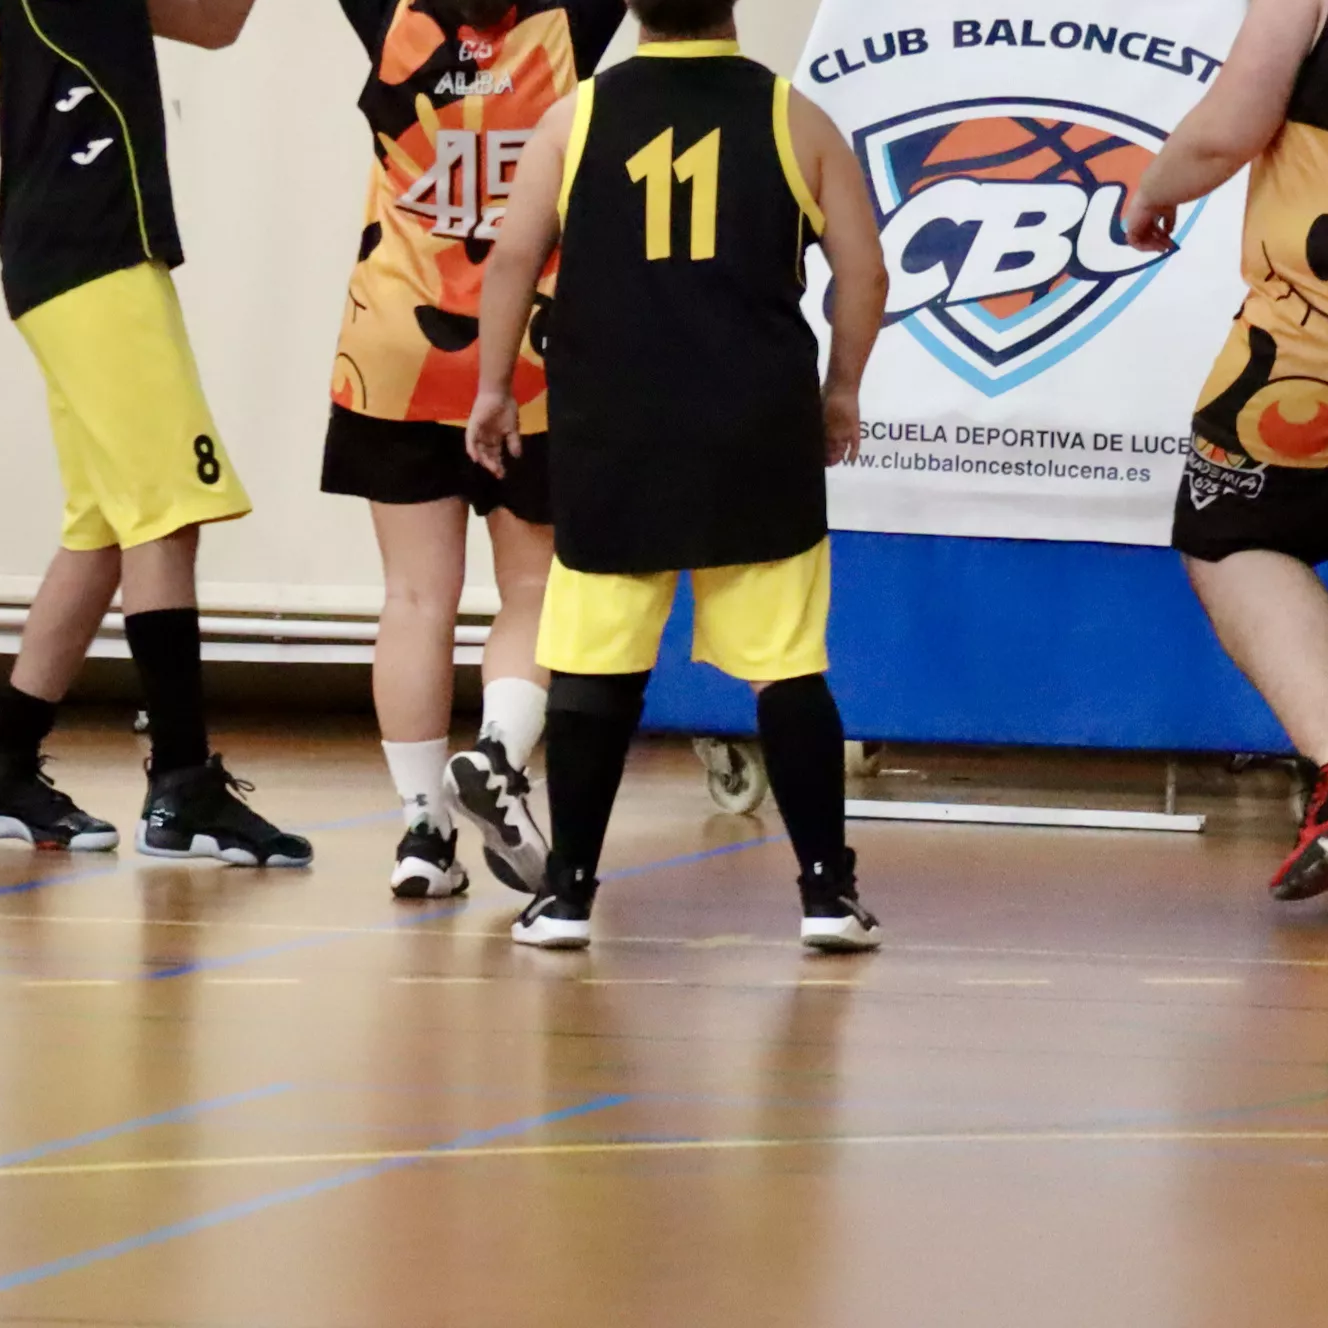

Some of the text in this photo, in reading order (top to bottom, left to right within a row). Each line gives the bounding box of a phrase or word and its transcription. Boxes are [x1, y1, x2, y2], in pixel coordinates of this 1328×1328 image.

[809, 27, 929, 84] CLUB
[434, 71, 514, 96] ALBA
[625, 126, 721, 262] 11
[193, 434, 220, 484] 8
[956, 425, 1085, 450] DEPORTIVA
[1093, 433, 1124, 452] DE
